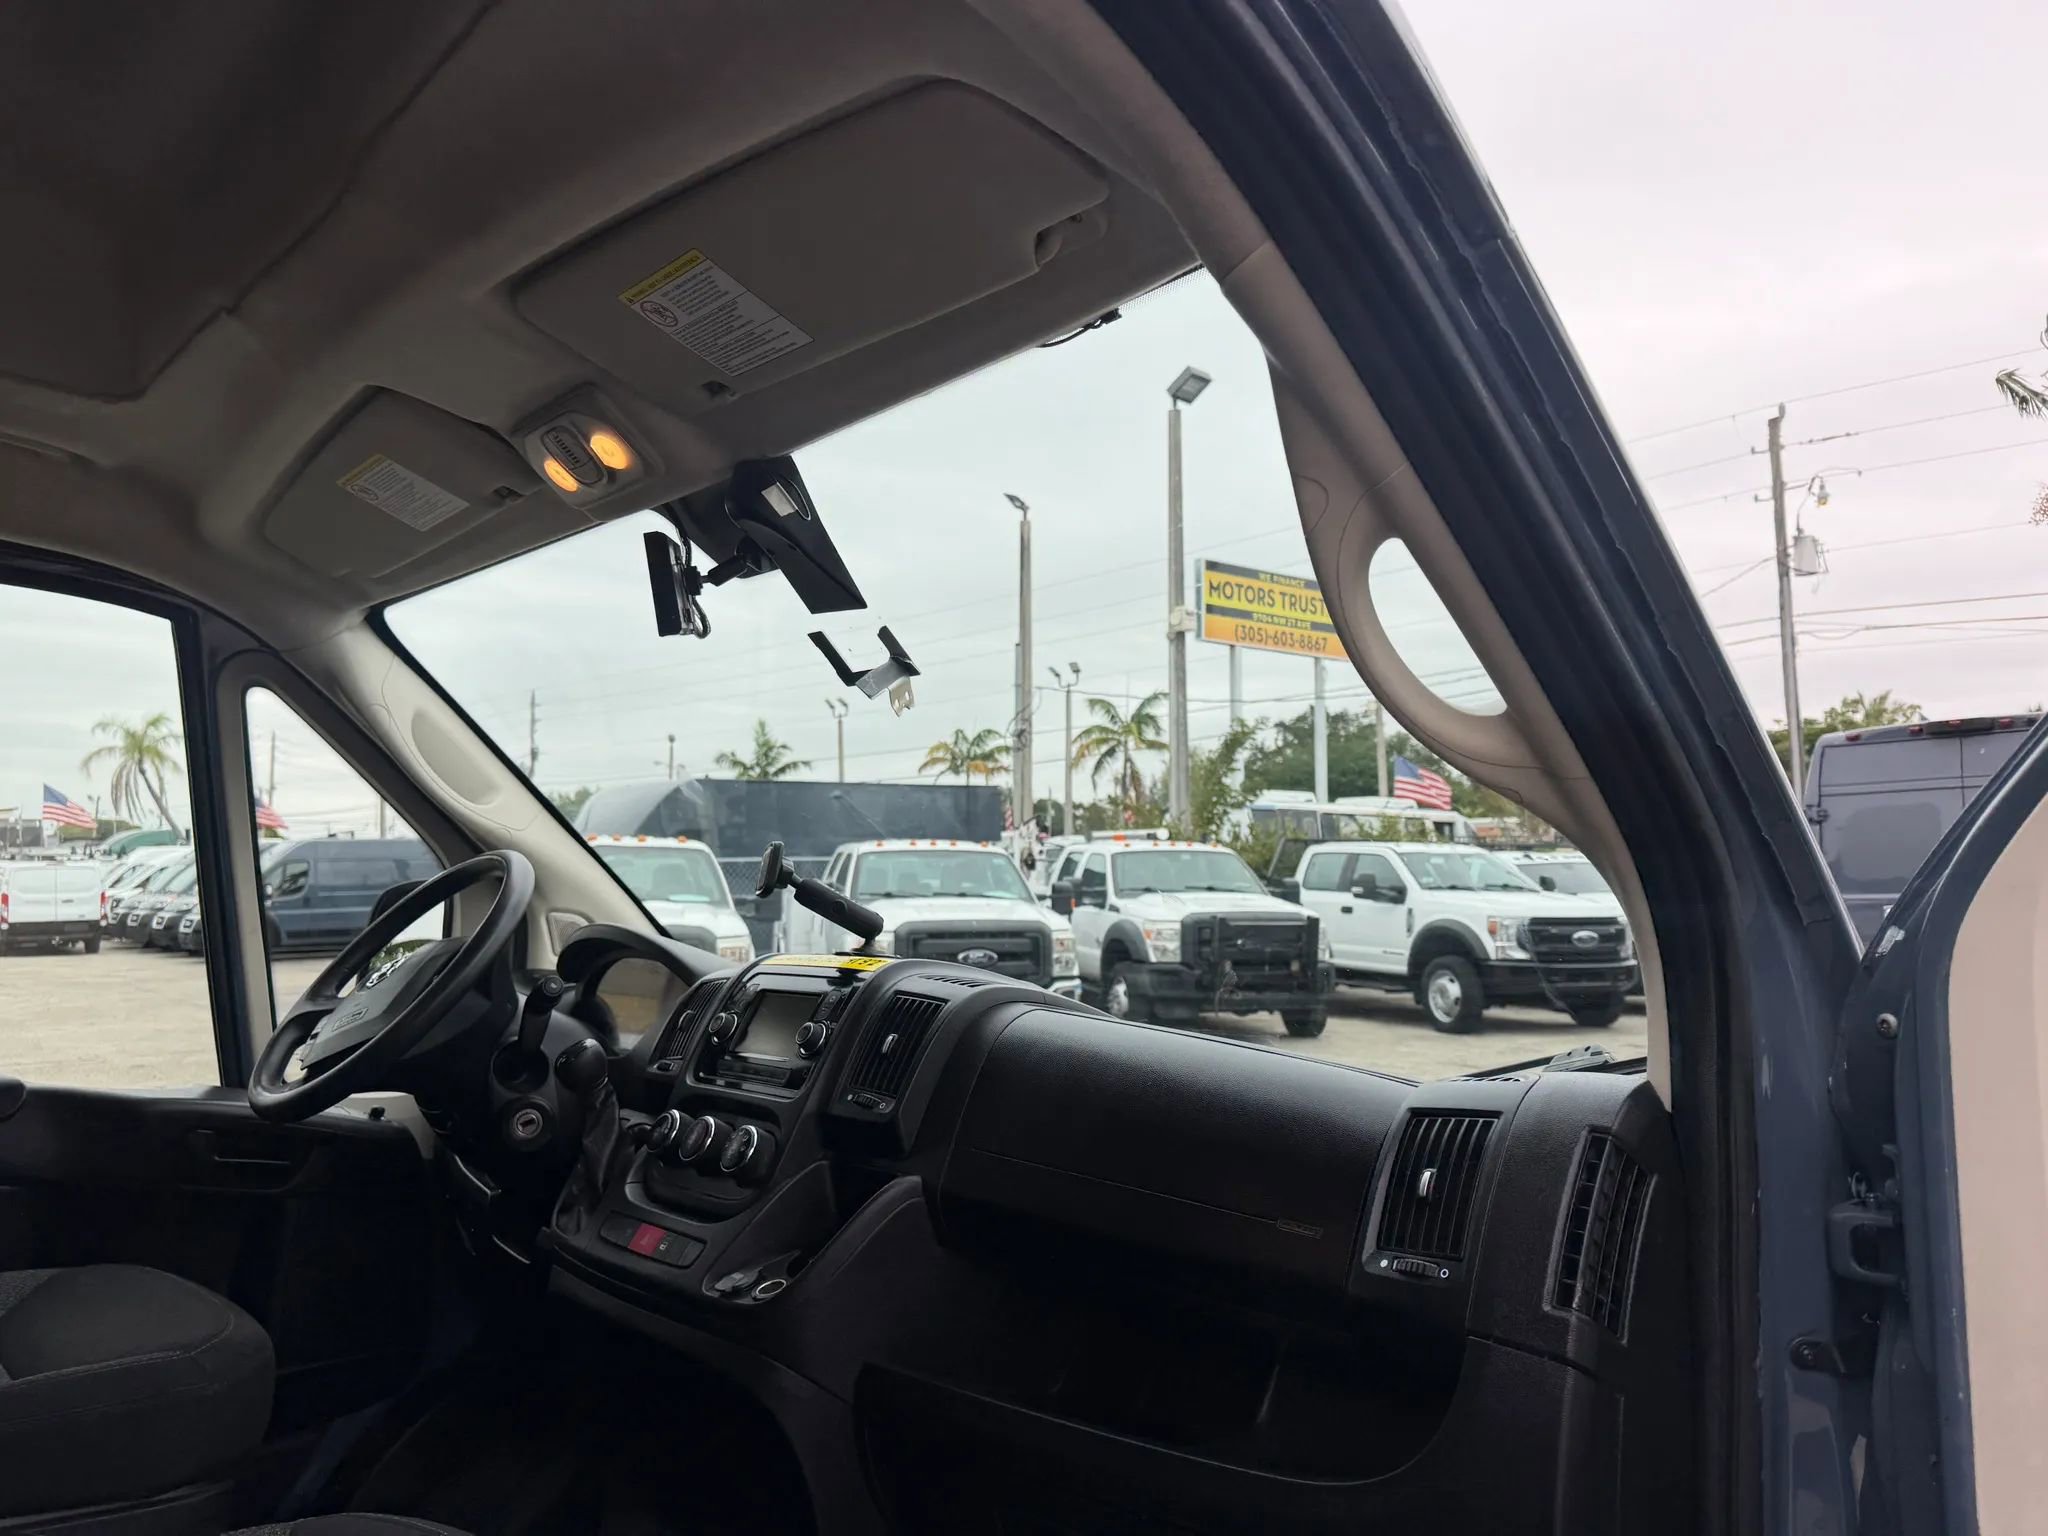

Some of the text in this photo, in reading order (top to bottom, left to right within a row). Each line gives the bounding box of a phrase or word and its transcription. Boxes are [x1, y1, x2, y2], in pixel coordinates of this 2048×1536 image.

[1208, 579, 1325, 617] MOTORS TRUST
[1235, 624, 1328, 651] (305)-603-8867
